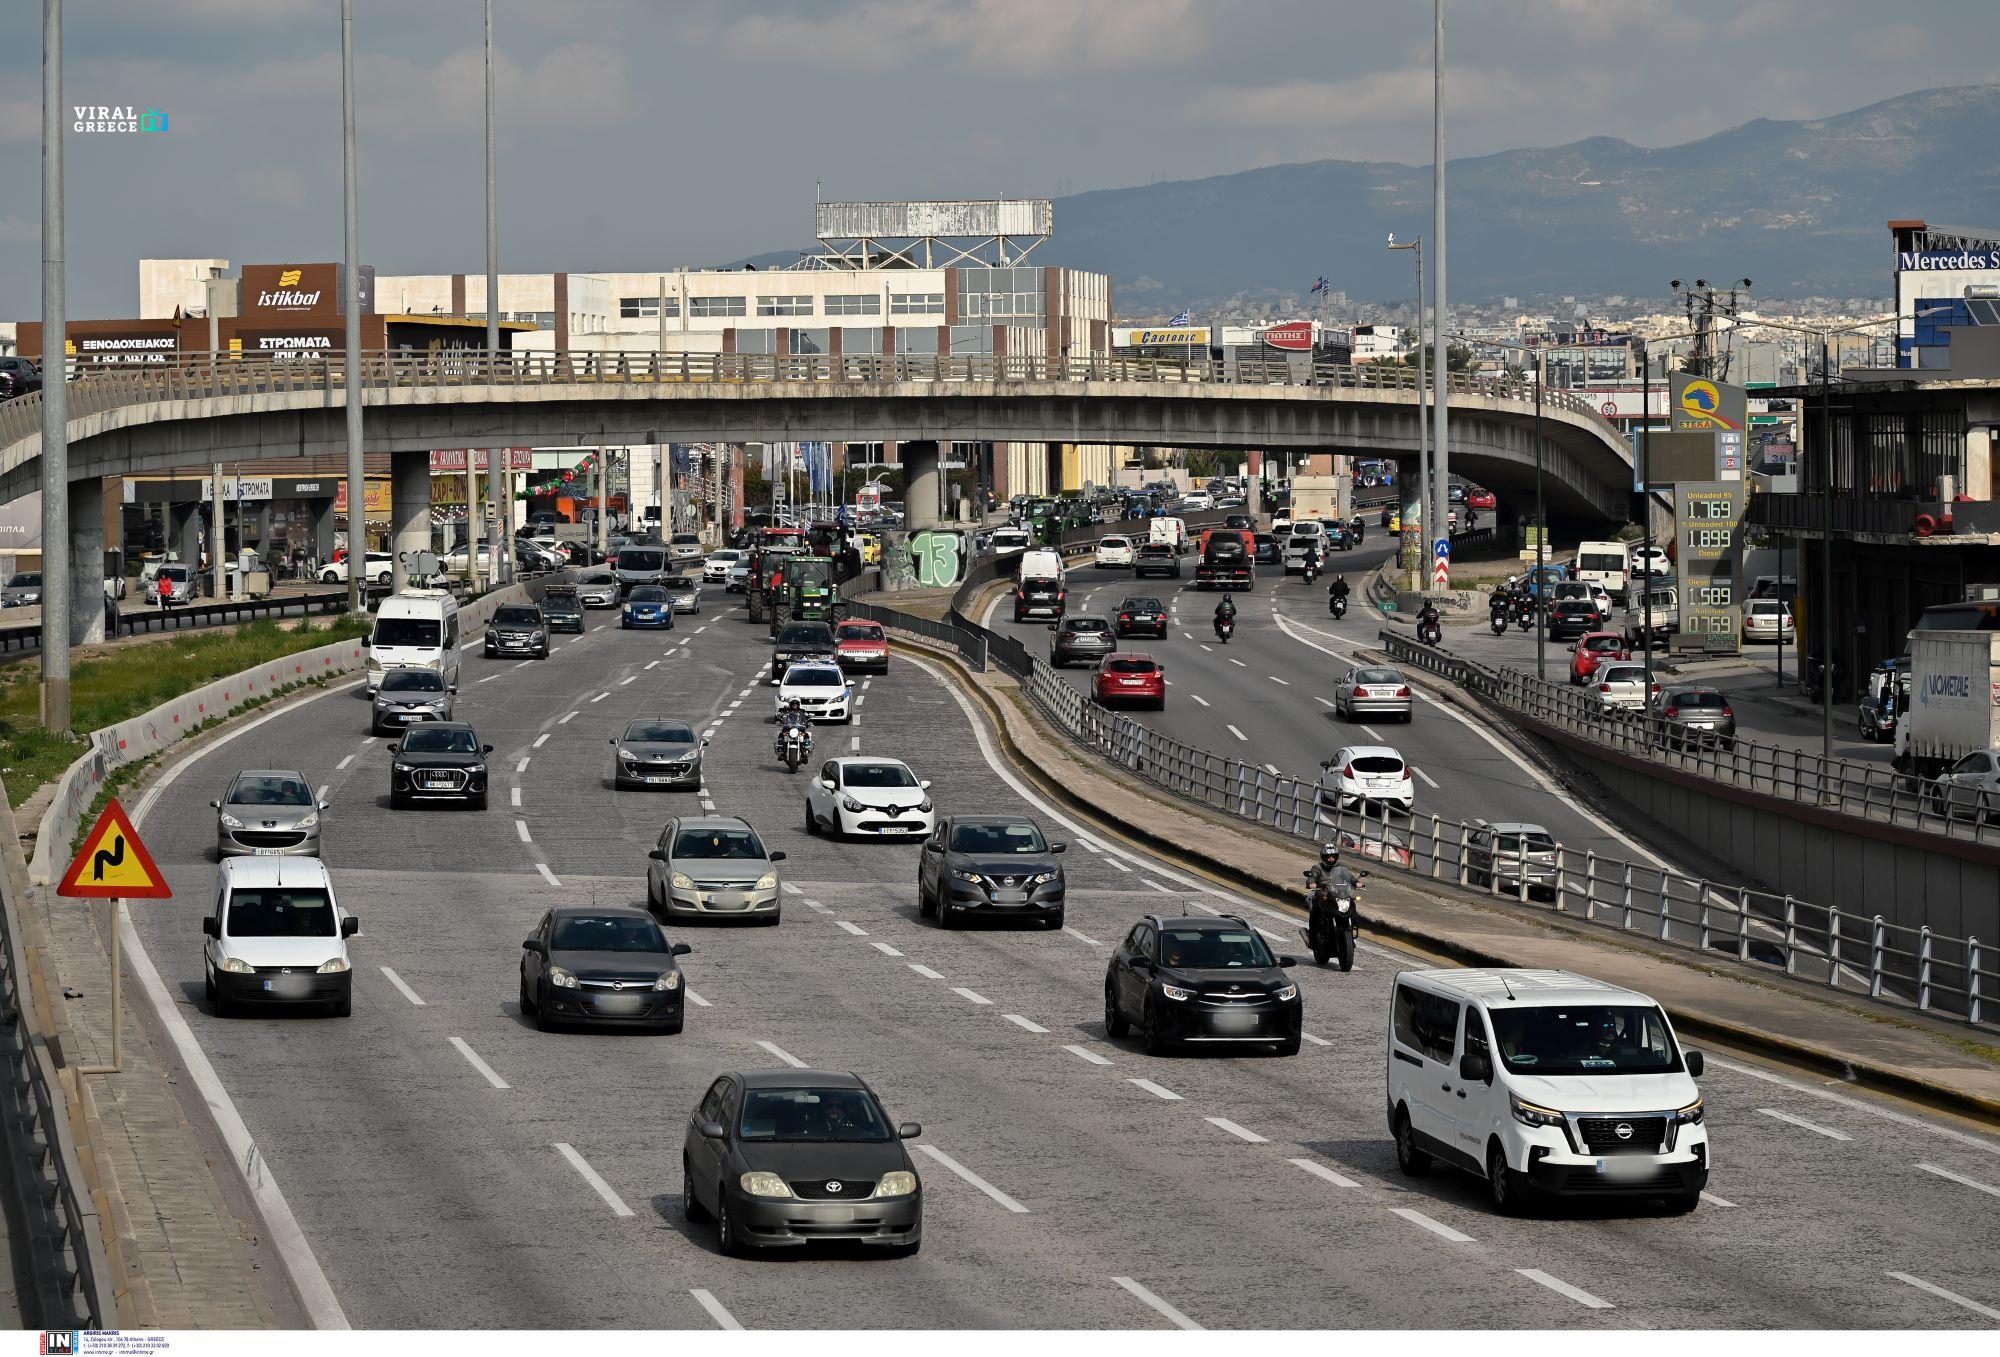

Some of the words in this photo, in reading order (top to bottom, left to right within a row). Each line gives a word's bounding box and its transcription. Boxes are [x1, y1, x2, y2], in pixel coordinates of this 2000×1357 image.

[1900, 251, 1986, 270] Mercedes
[257, 290, 321, 306] istikbal
[259, 337, 331, 349] ΣΤΡΩΜΑΤΑ
[1265, 332, 1302, 340] ΓΙΩΤΗΣ
[82, 339, 175, 350] ΞΕΝΟΔΟΧΕΙΑΚΟΣ
[1688, 501, 1731, 519] 1.769
[1726, 520, 1738, 528] 100
[1688, 530, 1731, 548] 1.899
[911, 531, 961, 588] 13
[1698, 549, 1722, 557] Diesel
[1688, 578, 1711, 586] Diesel
[1688, 587, 1731, 606] 1.589
[1688, 616, 1731, 633] 0.769
